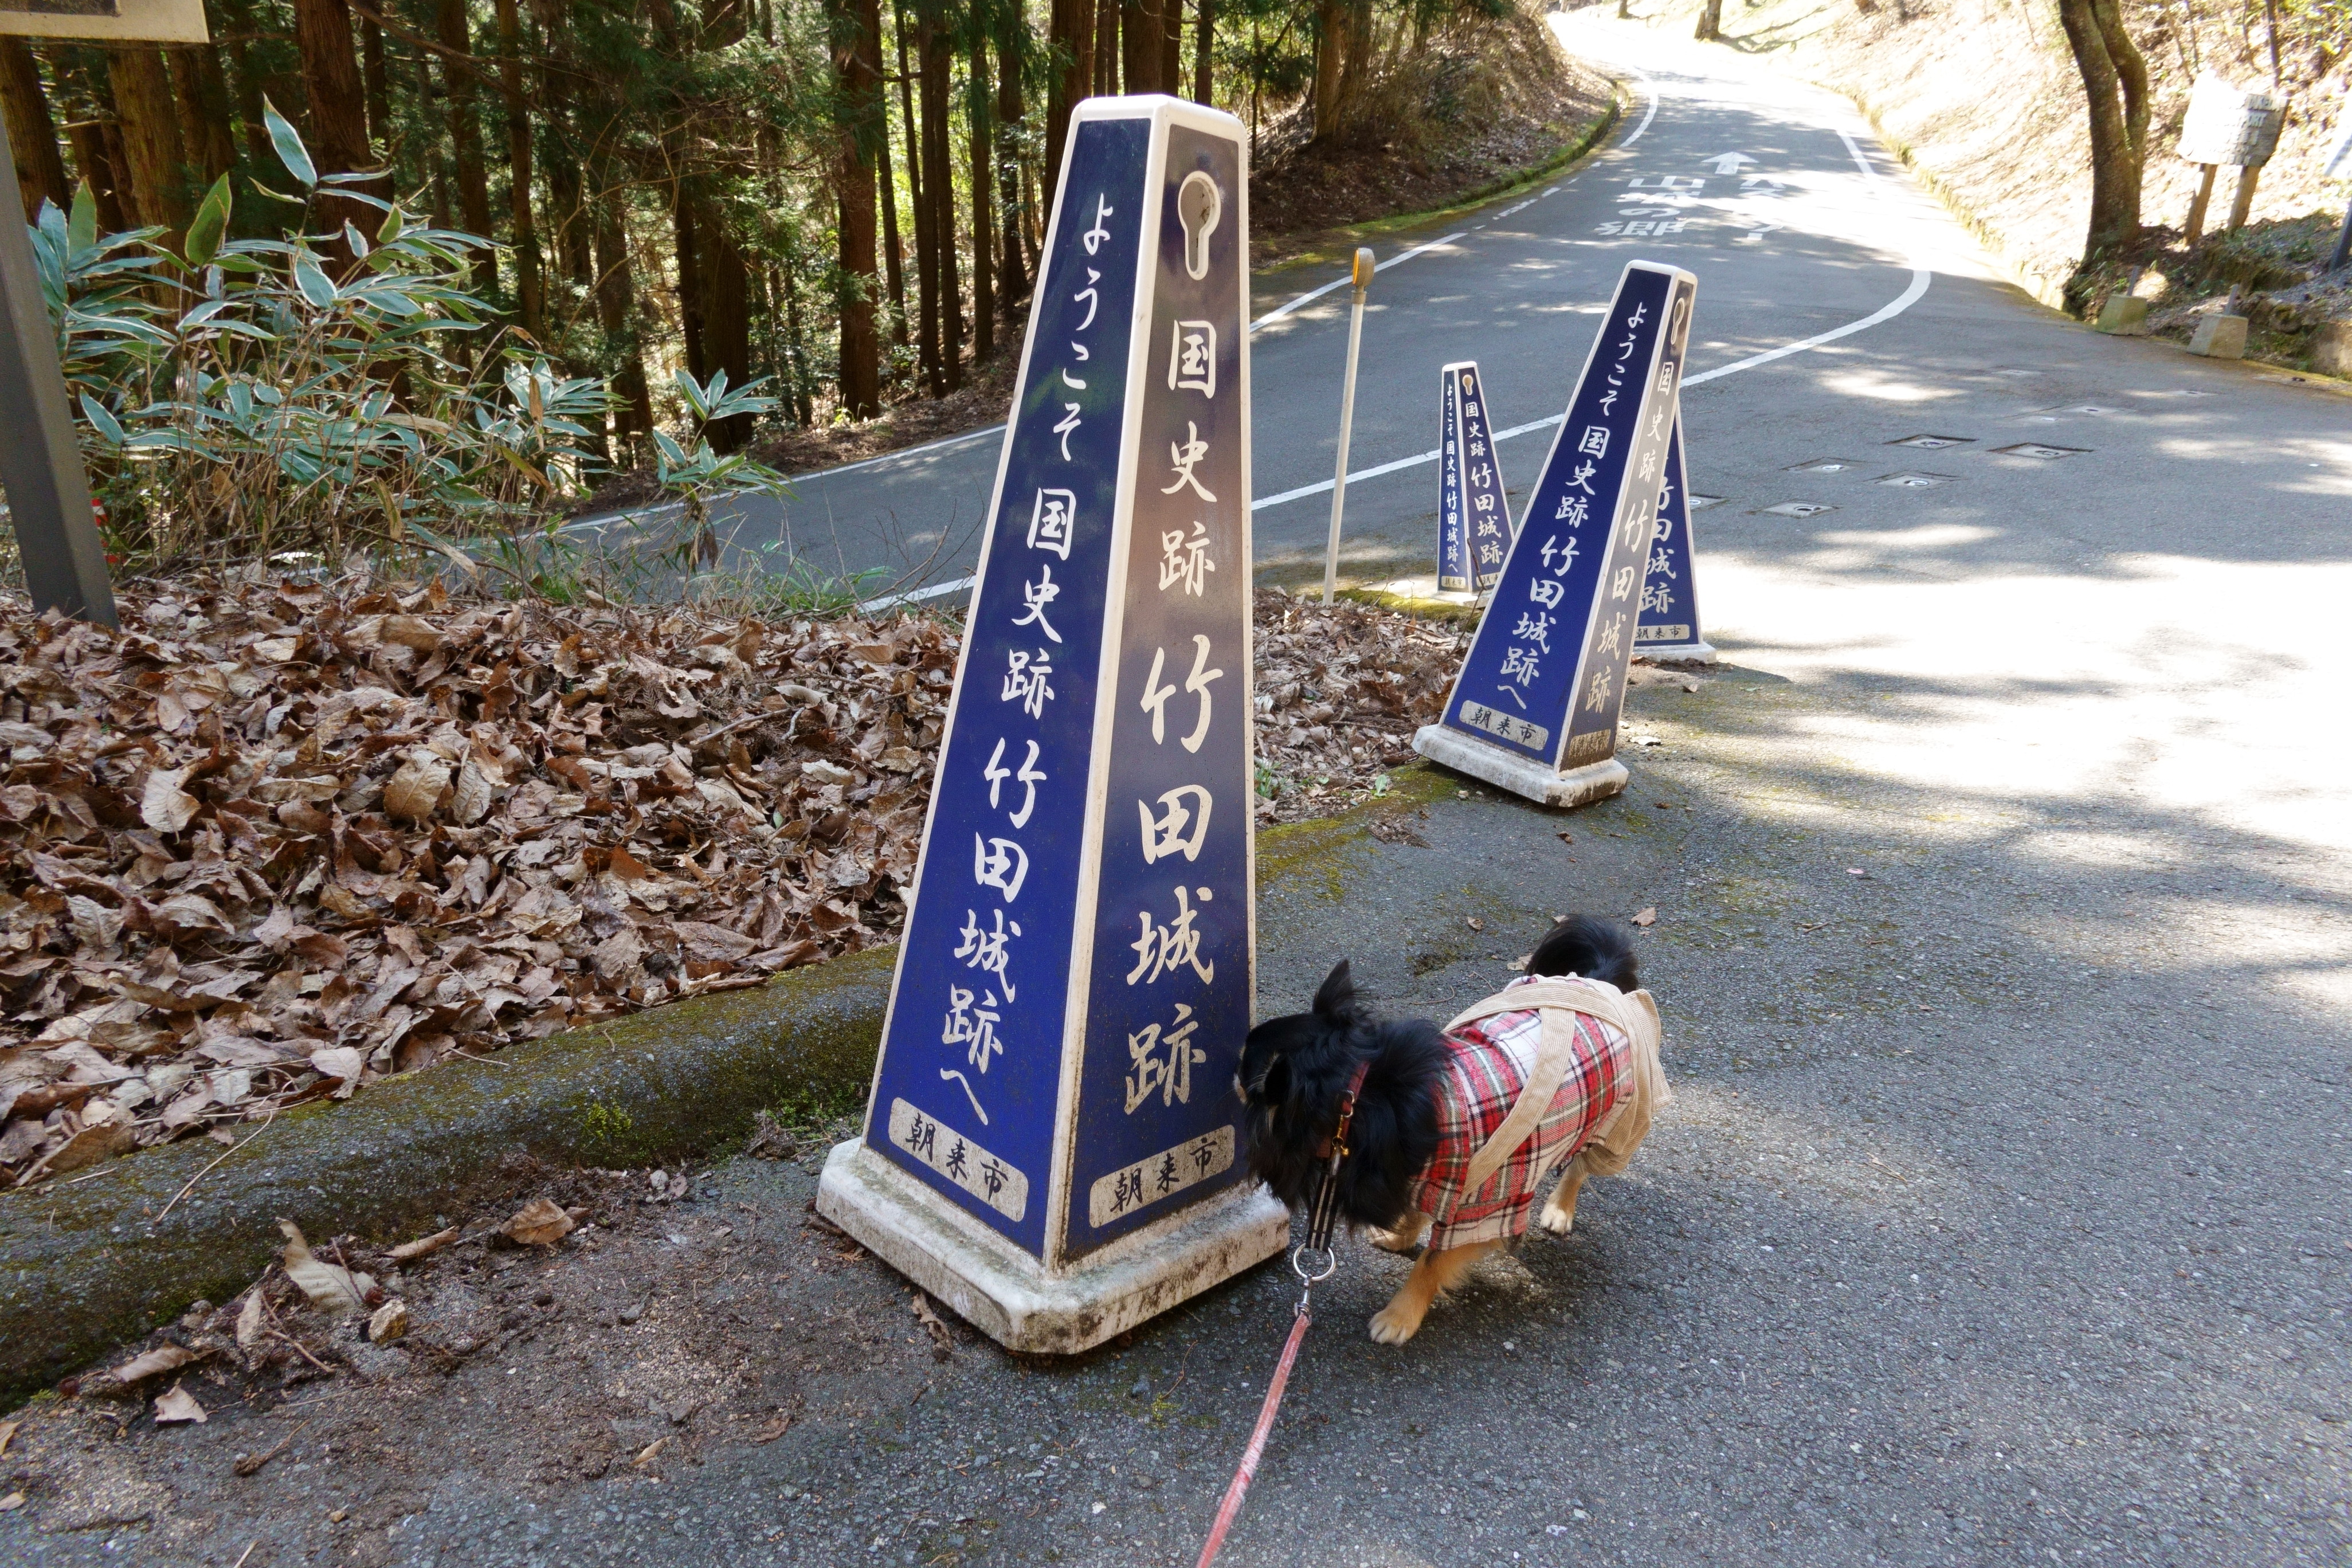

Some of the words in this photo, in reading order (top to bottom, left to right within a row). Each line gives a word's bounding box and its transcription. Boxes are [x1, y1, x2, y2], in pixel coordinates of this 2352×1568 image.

[1636, 625, 1681, 640] 朝来市
[1124, 319, 1224, 1115] 国史跡竹田城跡
[1472, 707, 1538, 752] 朝来市
[905, 1112, 1009, 1202] 朝来市
[1109, 1137, 1214, 1213] 朝来市
